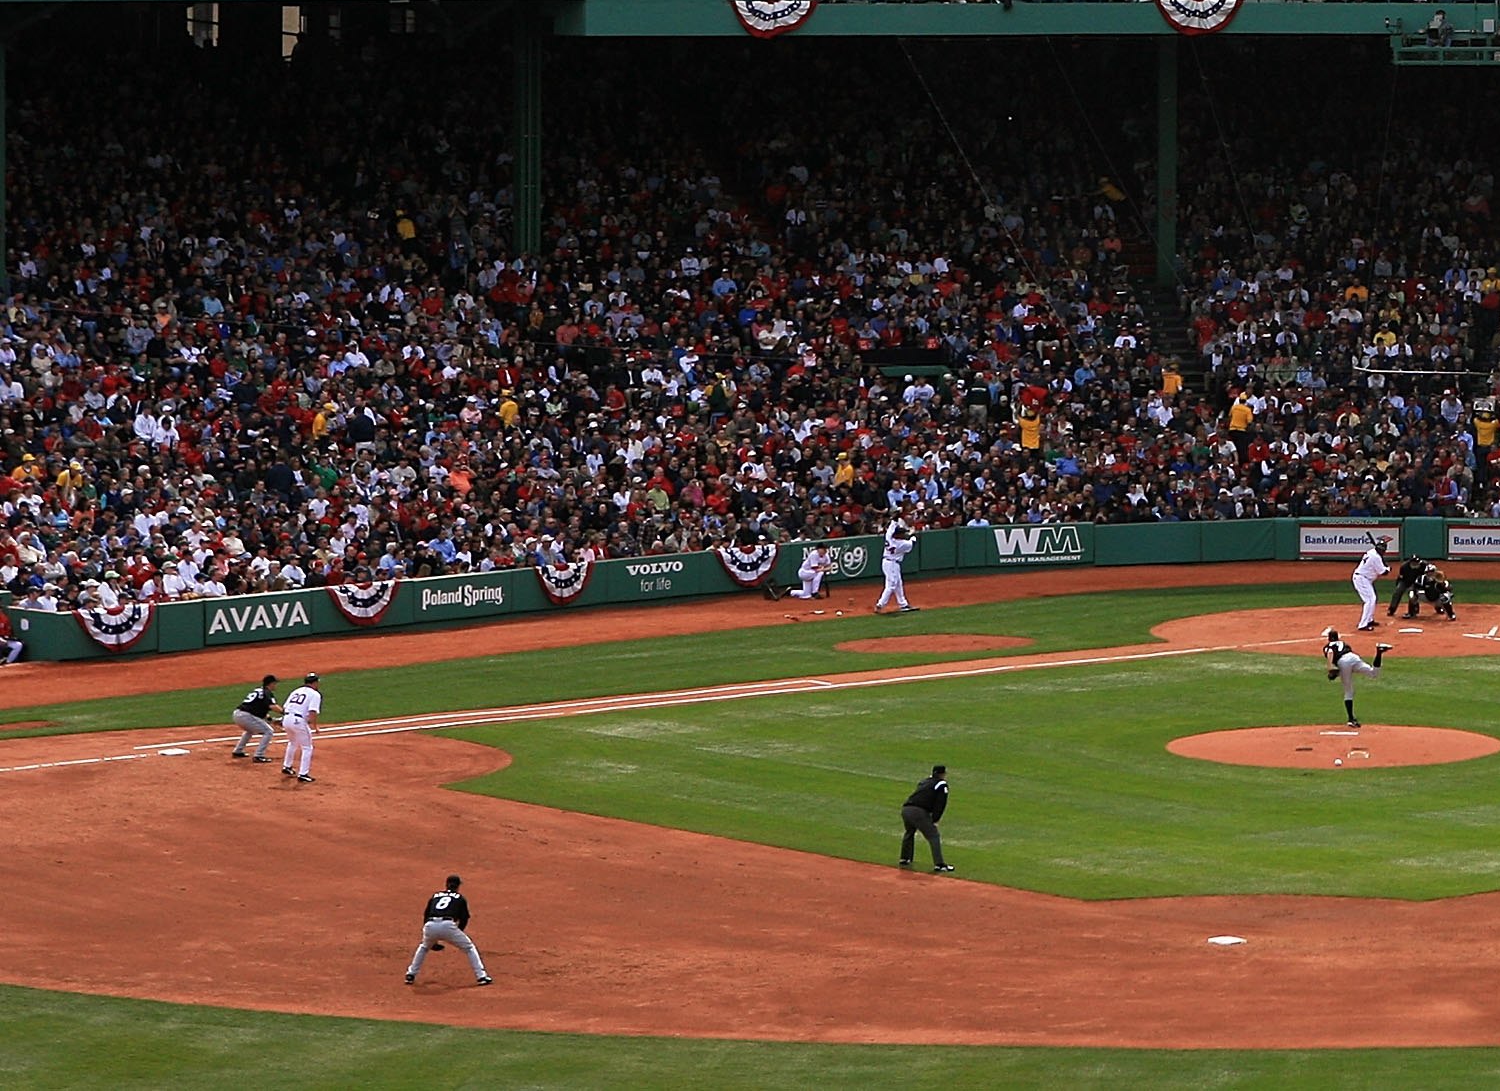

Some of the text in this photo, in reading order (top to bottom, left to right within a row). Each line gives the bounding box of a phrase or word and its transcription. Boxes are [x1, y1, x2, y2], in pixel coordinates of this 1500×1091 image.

[993, 526, 1081, 555] WM
[1304, 536, 1328, 544] Bank
[1328, 535, 1337, 544] of
[1453, 536, 1476, 545] Bank
[1476, 536, 1485, 545] of
[625, 561, 683, 576] VOLVO
[640, 577, 671, 591] for life
[422, 584, 503, 610] Poland Spring
[208, 600, 310, 635] AVAYA
[289, 693, 307, 705] 20
